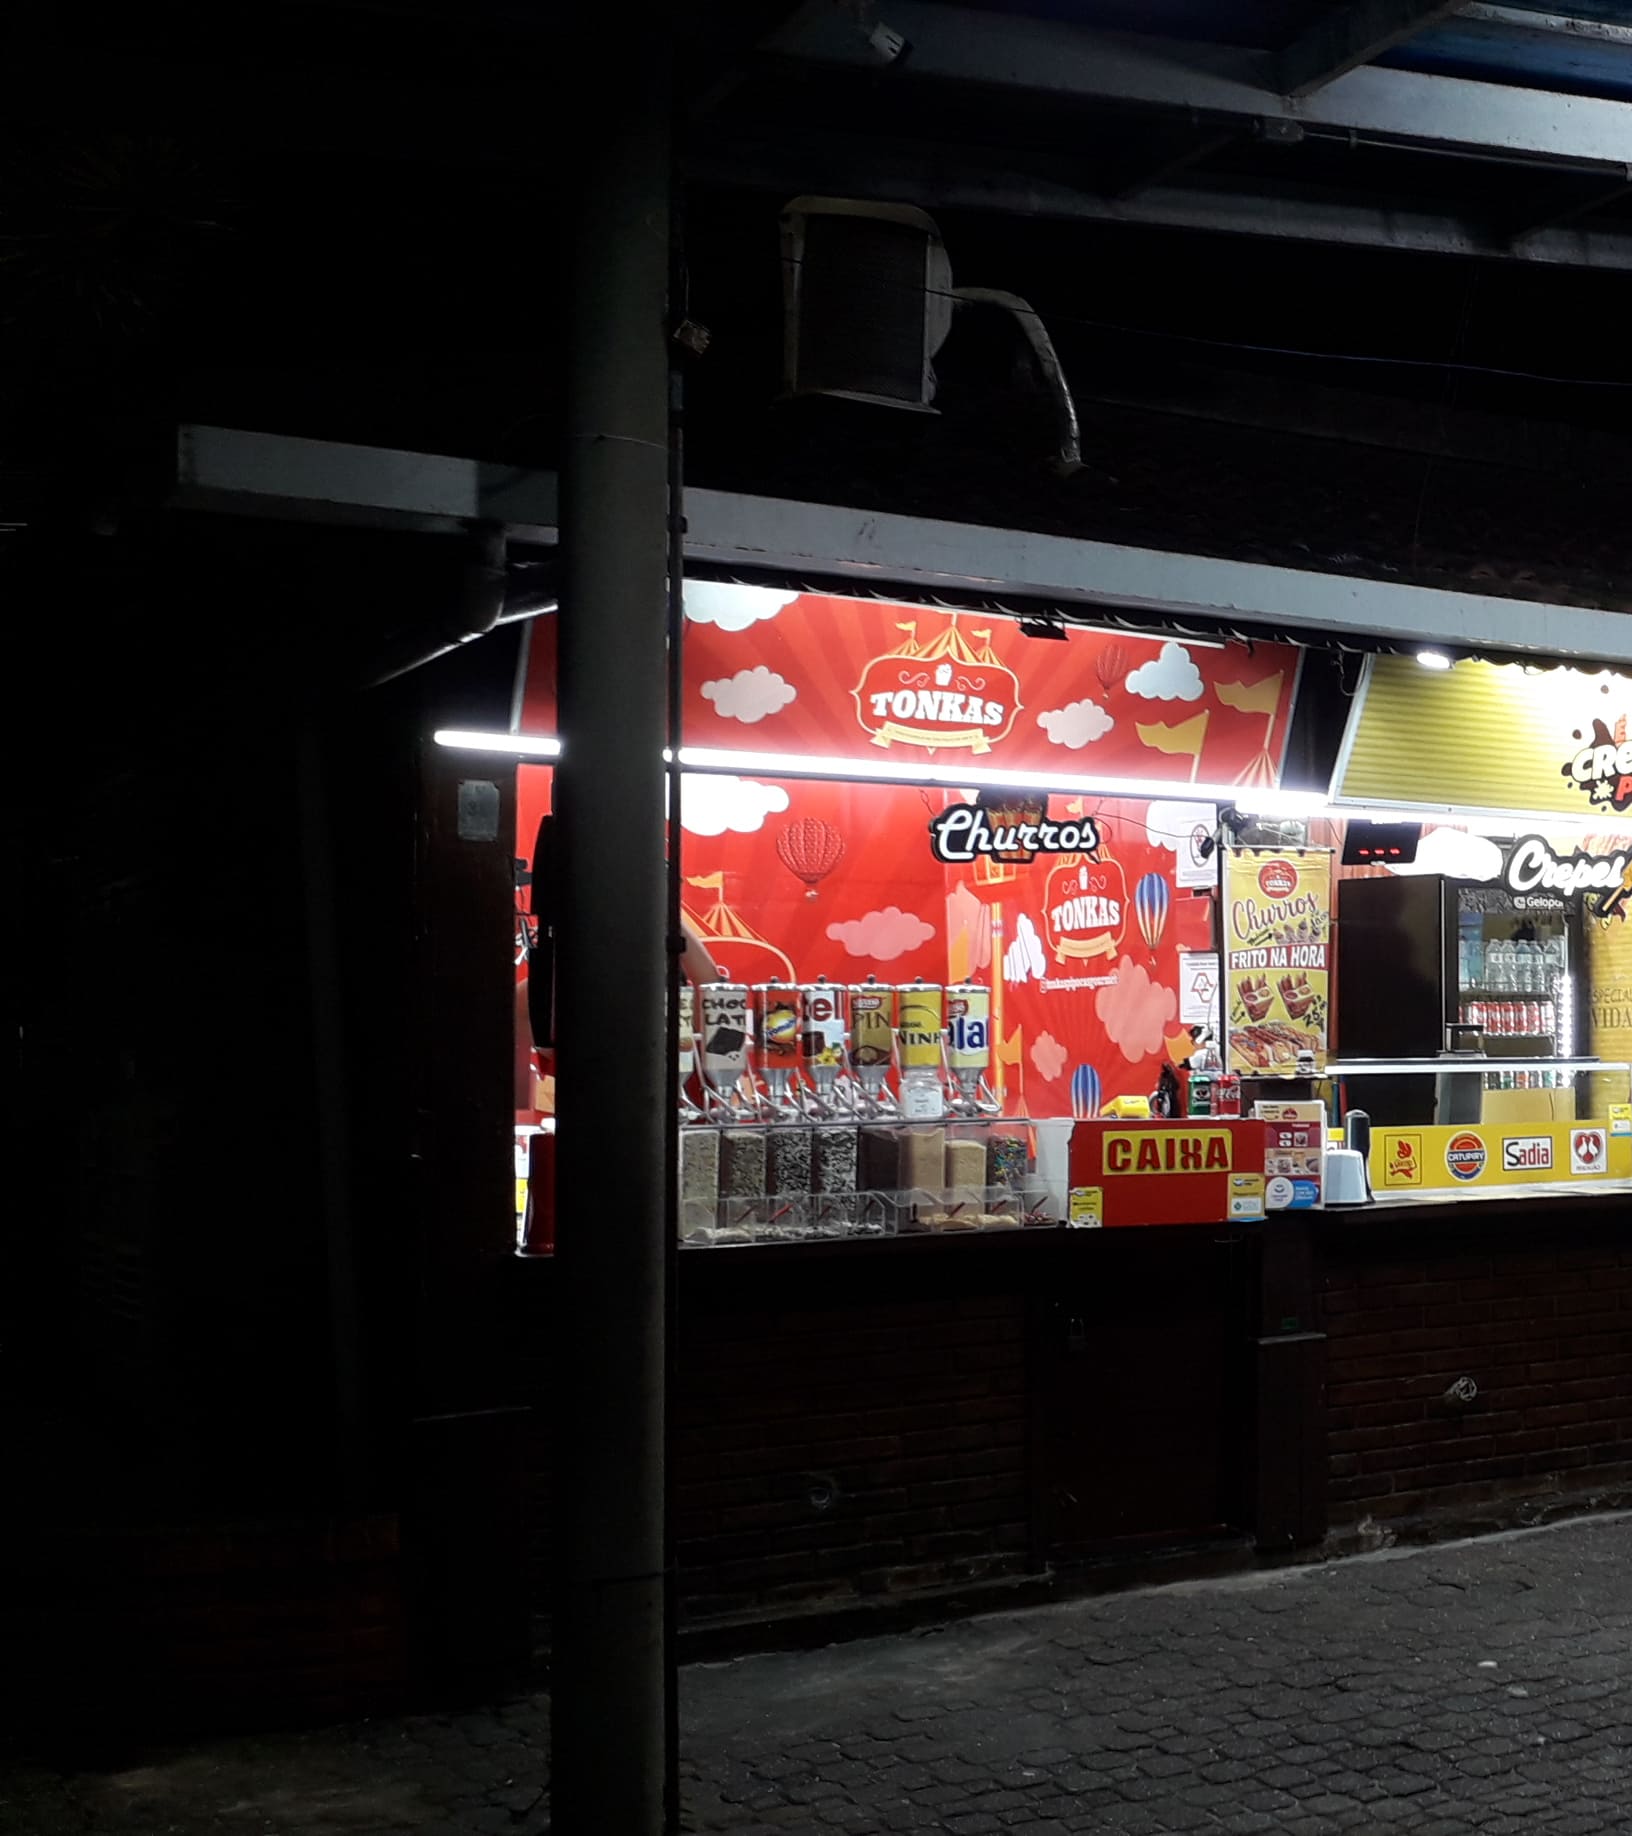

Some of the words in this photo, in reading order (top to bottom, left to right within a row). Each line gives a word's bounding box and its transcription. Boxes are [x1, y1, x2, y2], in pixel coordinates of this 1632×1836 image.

[870, 689, 1004, 726] TONKAS
[936, 809, 1097, 860] Churros
[1508, 839, 1626, 896] Crepes
[1051, 895, 1121, 933] TONKAS
[1232, 893, 1319, 940] Churros
[1231, 948, 1267, 969] FRITO
[1270, 946, 1288, 968] NA
[1291, 944, 1326, 969] HORA
[1107, 1135, 1230, 1173] CAIXA
[1506, 1141, 1550, 1167] Sadia
